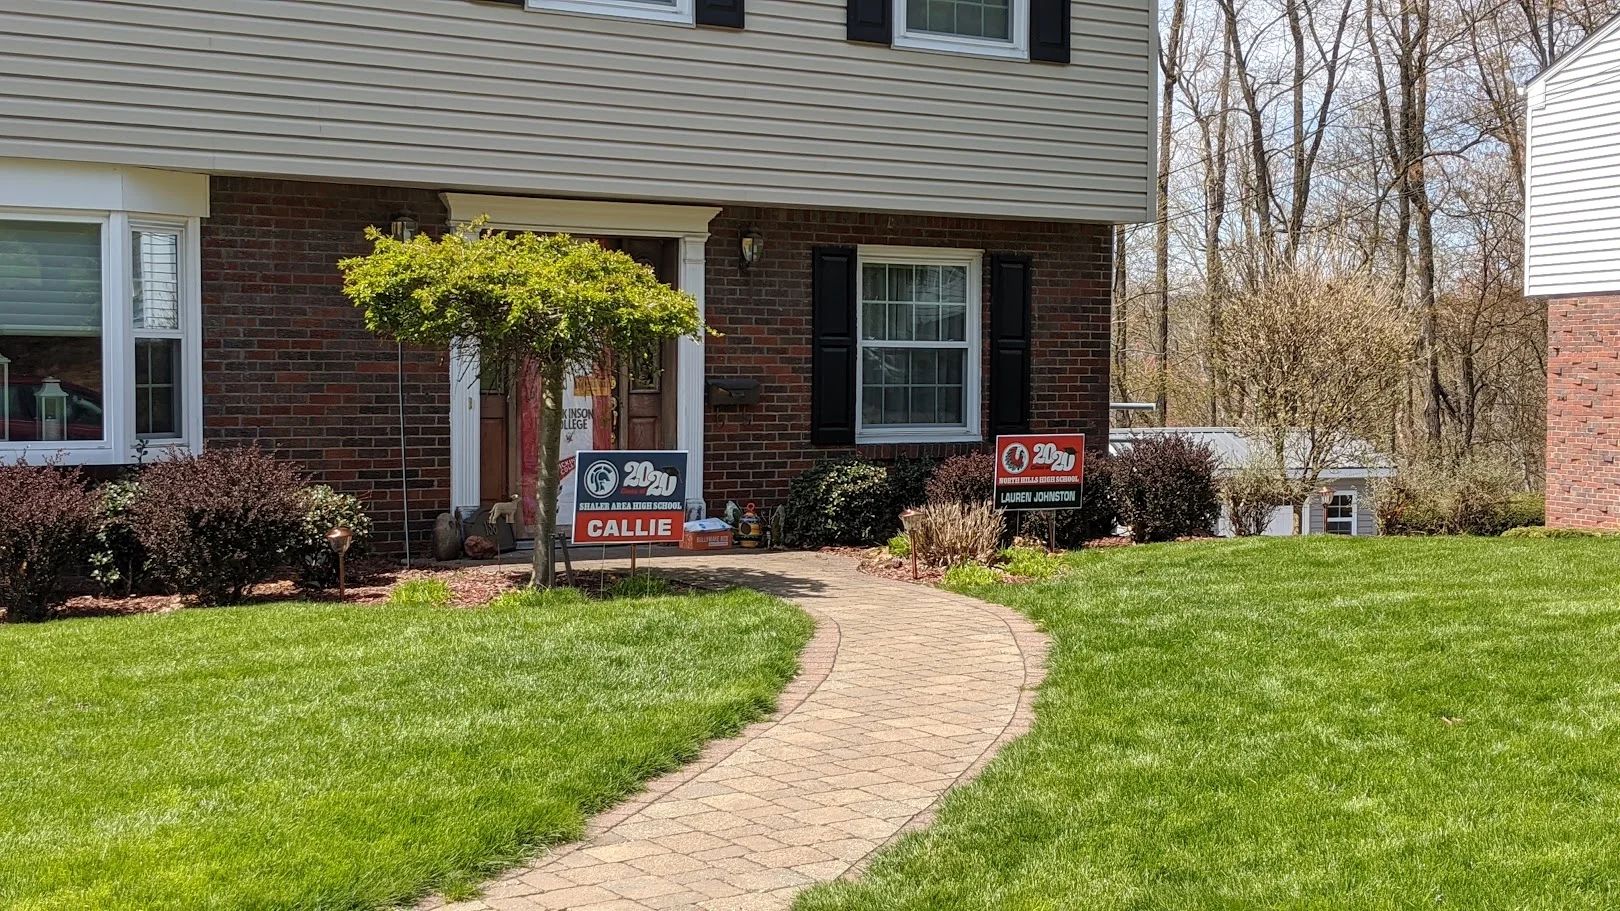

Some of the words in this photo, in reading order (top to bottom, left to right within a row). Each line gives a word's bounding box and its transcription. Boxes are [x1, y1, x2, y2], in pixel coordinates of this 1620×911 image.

[562, 408, 594, 419] KINSON
[560, 419, 588, 430] OLLEGE
[1033, 443, 1075, 472] 2020
[623, 460, 678, 497] 2020
[999, 476, 1020, 484] NORTH
[1020, 476, 1039, 484] HILLS
[1056, 475, 1080, 483] SCHOOL
[1001, 491, 1033, 503] LAUREN
[1033, 490, 1076, 502] JOHNSTON
[579, 502, 610, 511] SHALER
[611, 502, 632, 511] AREA
[632, 501, 653, 510] HIGH
[653, 501, 682, 510] SCHOOL
[587, 519, 672, 537] CALLIE
